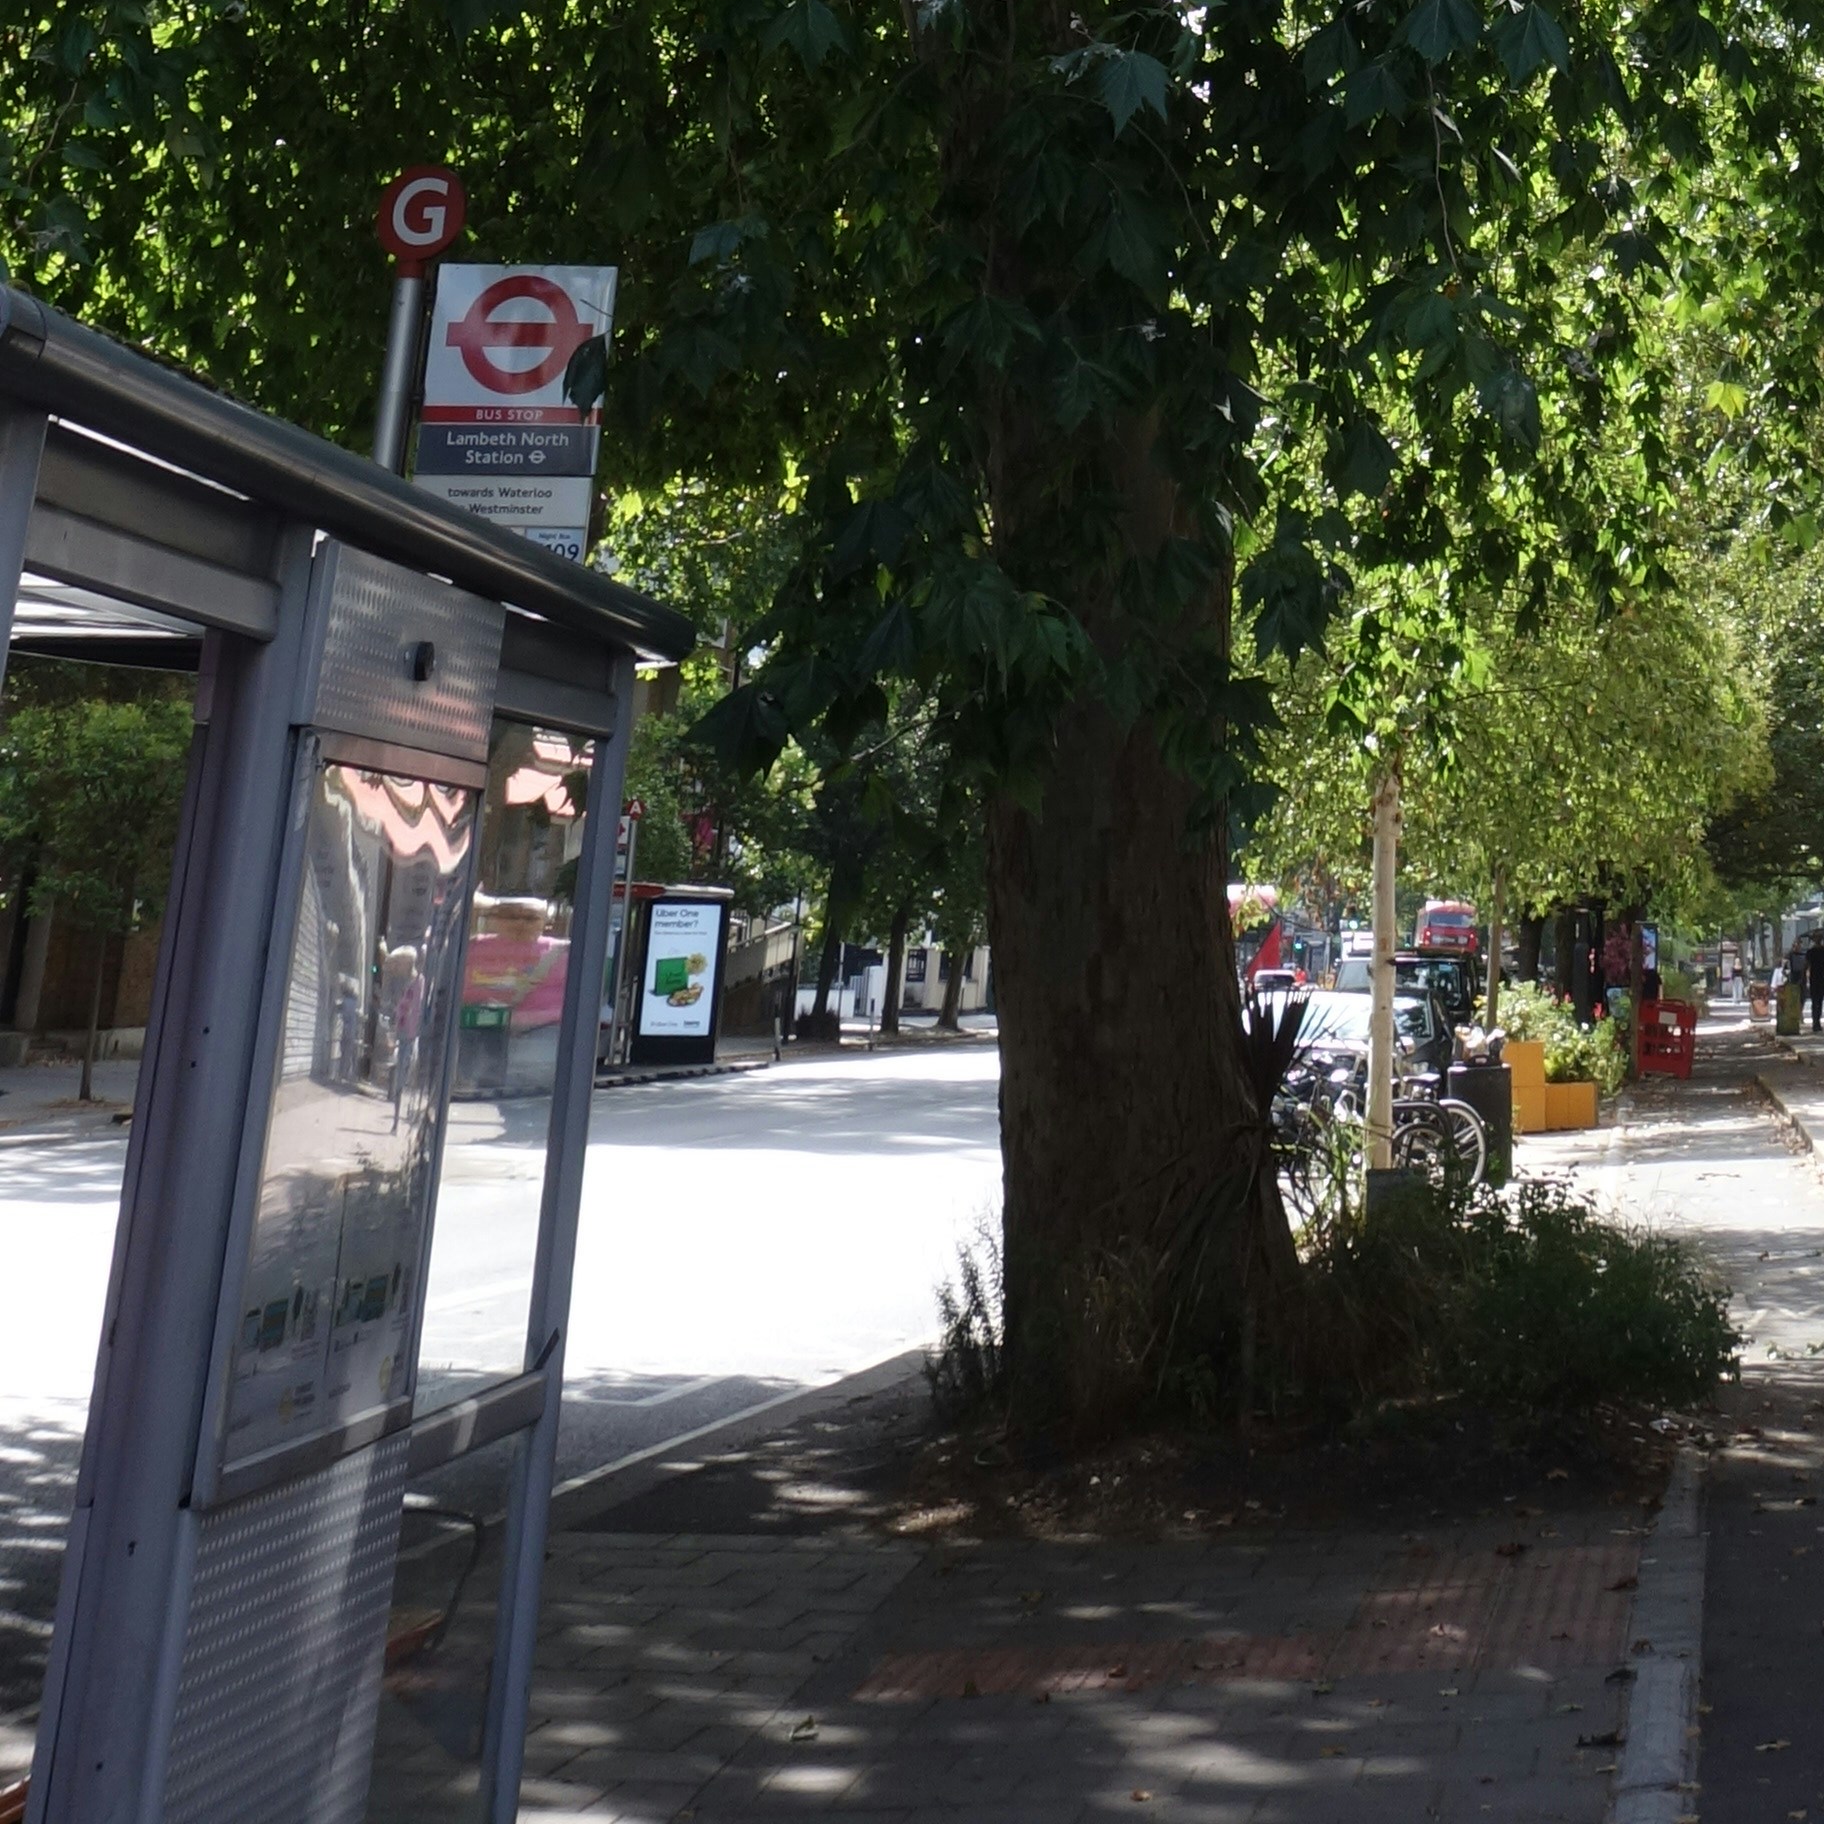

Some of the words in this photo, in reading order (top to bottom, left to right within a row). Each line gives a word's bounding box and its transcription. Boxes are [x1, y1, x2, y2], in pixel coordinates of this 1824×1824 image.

[392, 177, 448, 246] G
[475, 409, 501, 420] BUS
[507, 409, 544, 421] STOP
[446, 431, 516, 446] Lambeth
[521, 433, 569, 447] North
[465, 449, 524, 465] Station
[448, 487, 494, 498] towards
[498, 487, 553, 499] Waterloo
[468, 503, 544, 515] Westminster
[630, 801, 641, 814] A
[656, 908, 678, 918] Uber
[680, 908, 699, 918] One
[655, 920, 699, 928] member?
